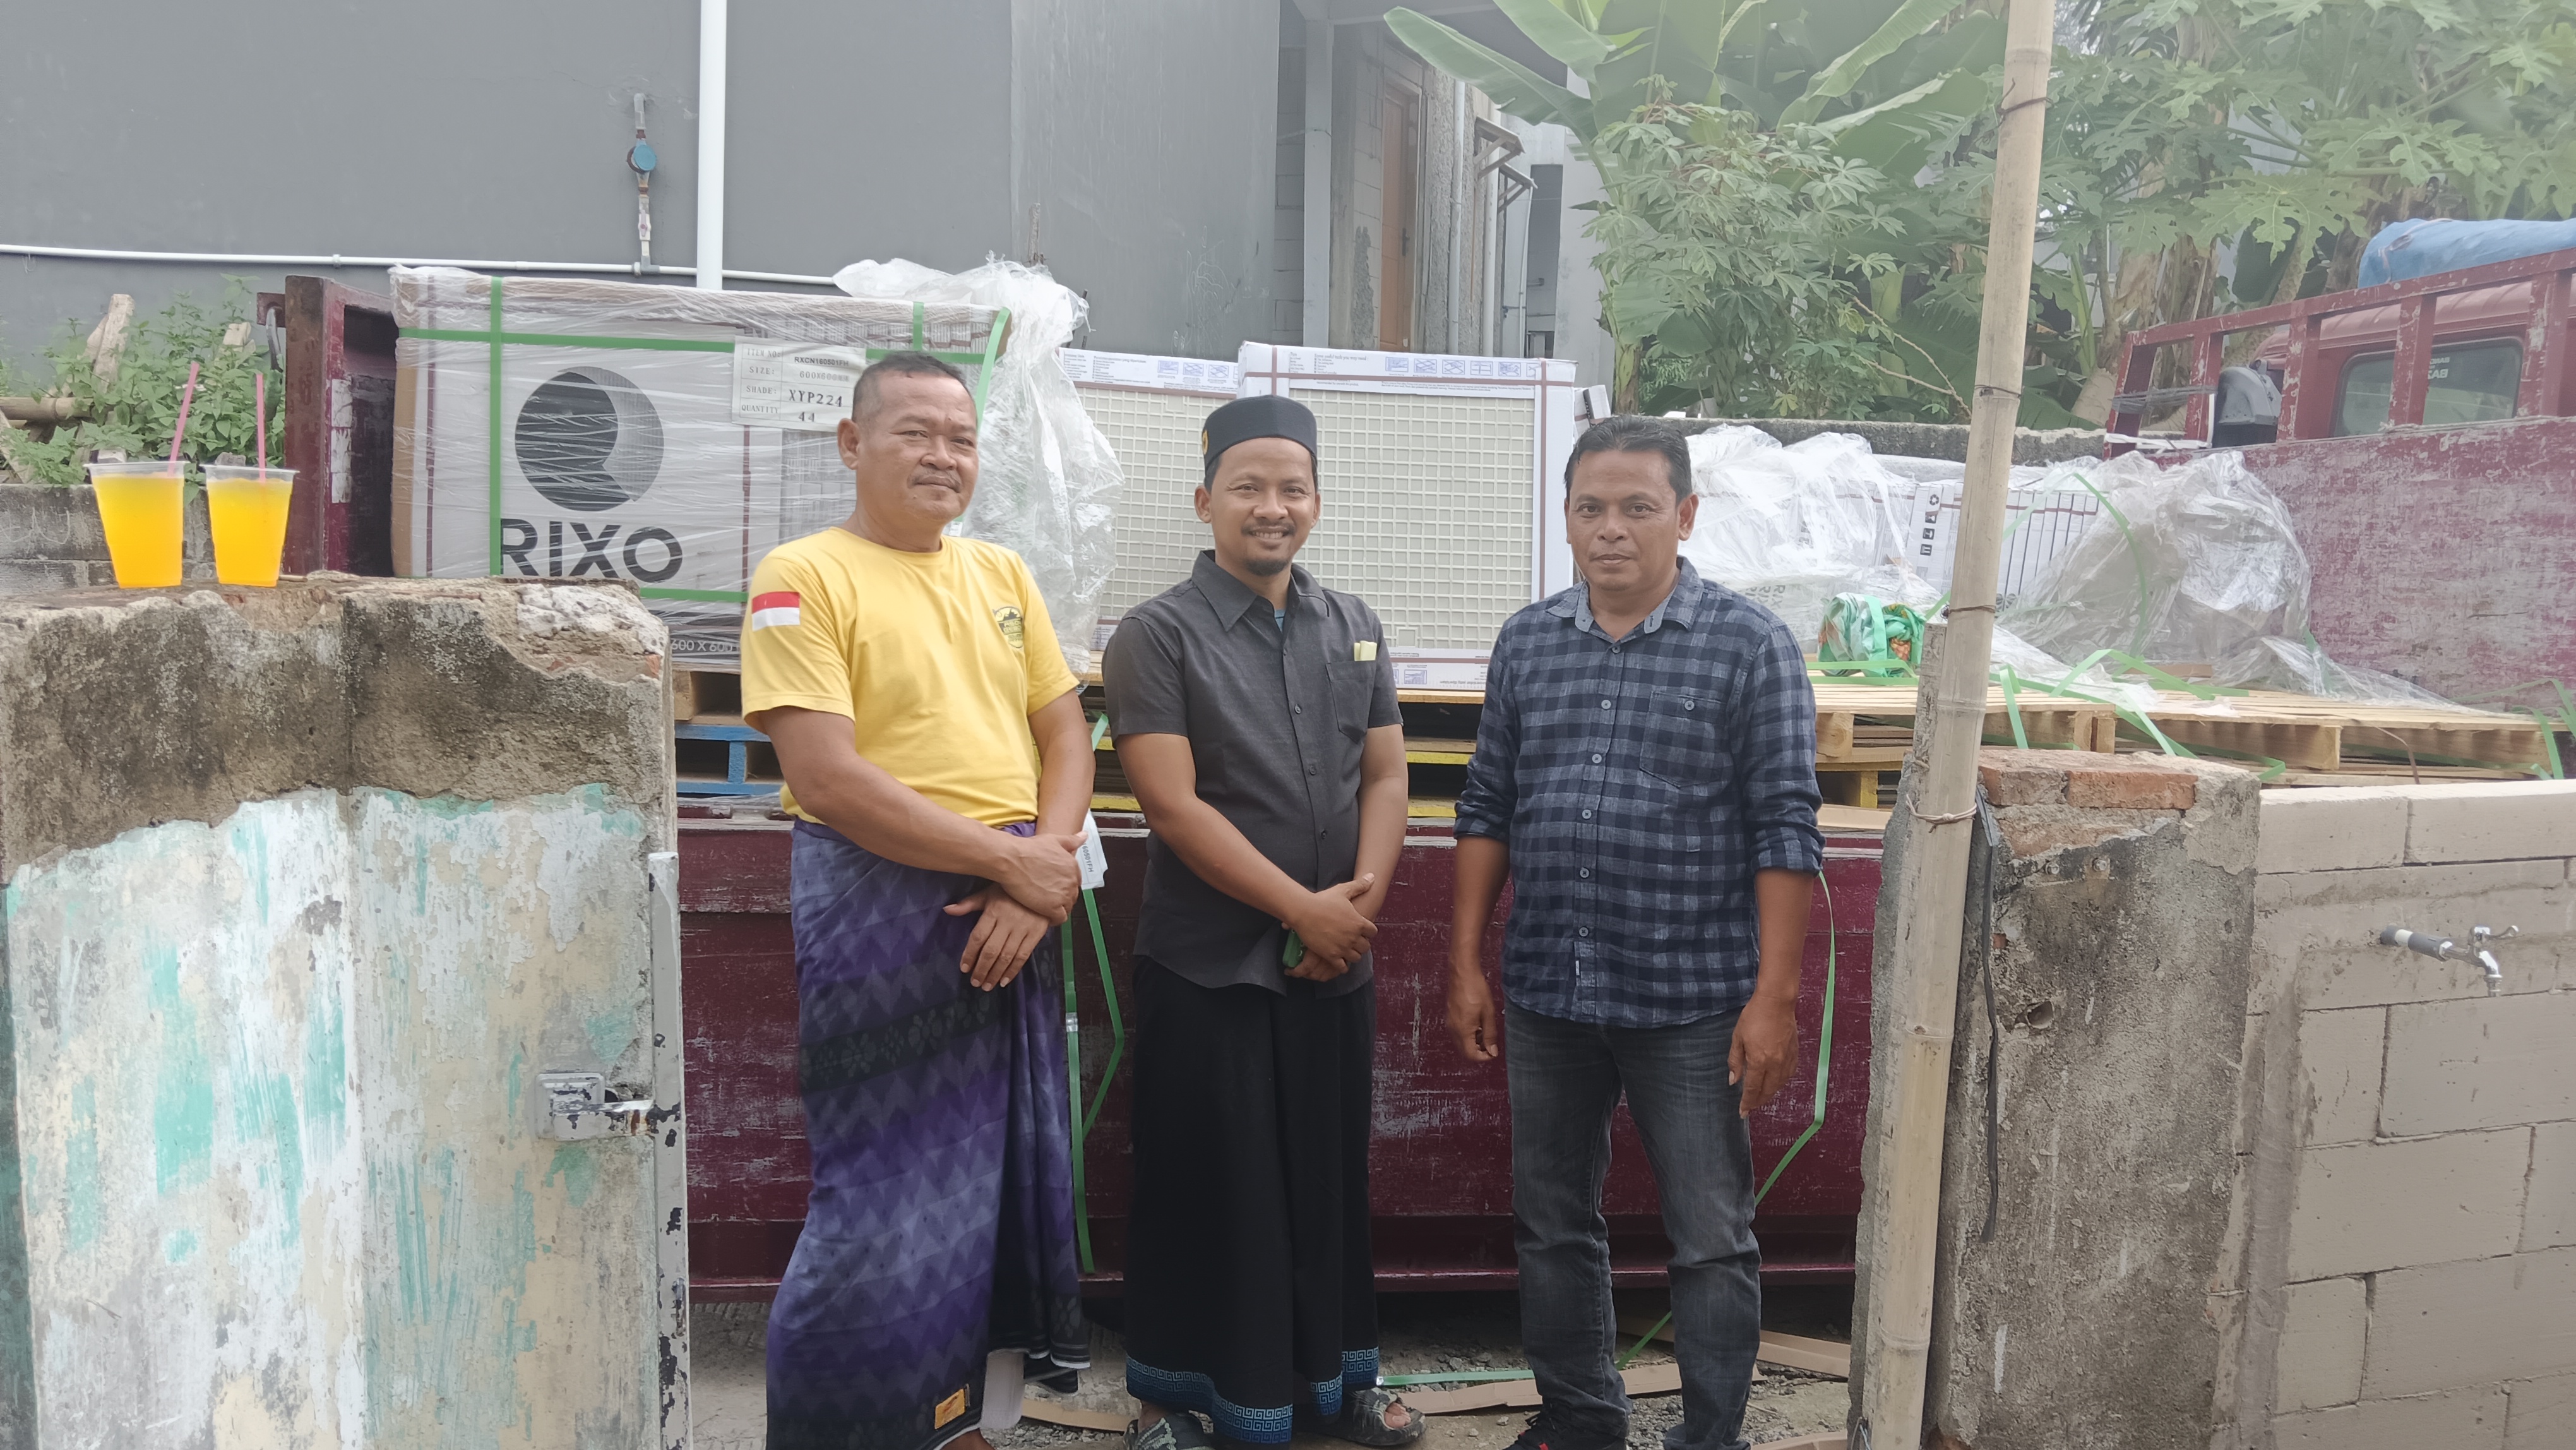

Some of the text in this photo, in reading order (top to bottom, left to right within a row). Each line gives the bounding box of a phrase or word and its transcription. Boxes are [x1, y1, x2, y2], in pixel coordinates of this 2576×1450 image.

[747, 348, 781, 358] ITEM NO:
[794, 356, 849, 367] RXCN160501FH
[749, 366, 775, 374] SIZE:
[746, 385, 777, 394] SHADE:
[789, 389, 843, 407] XYP224
[741, 404, 779, 414] QUANTITY
[798, 411, 815, 422] 44
[500, 518, 683, 584] RIXO
[1770, 585, 1786, 610] RIX
[671, 639, 695, 651] 600
[697, 640, 707, 652] X
